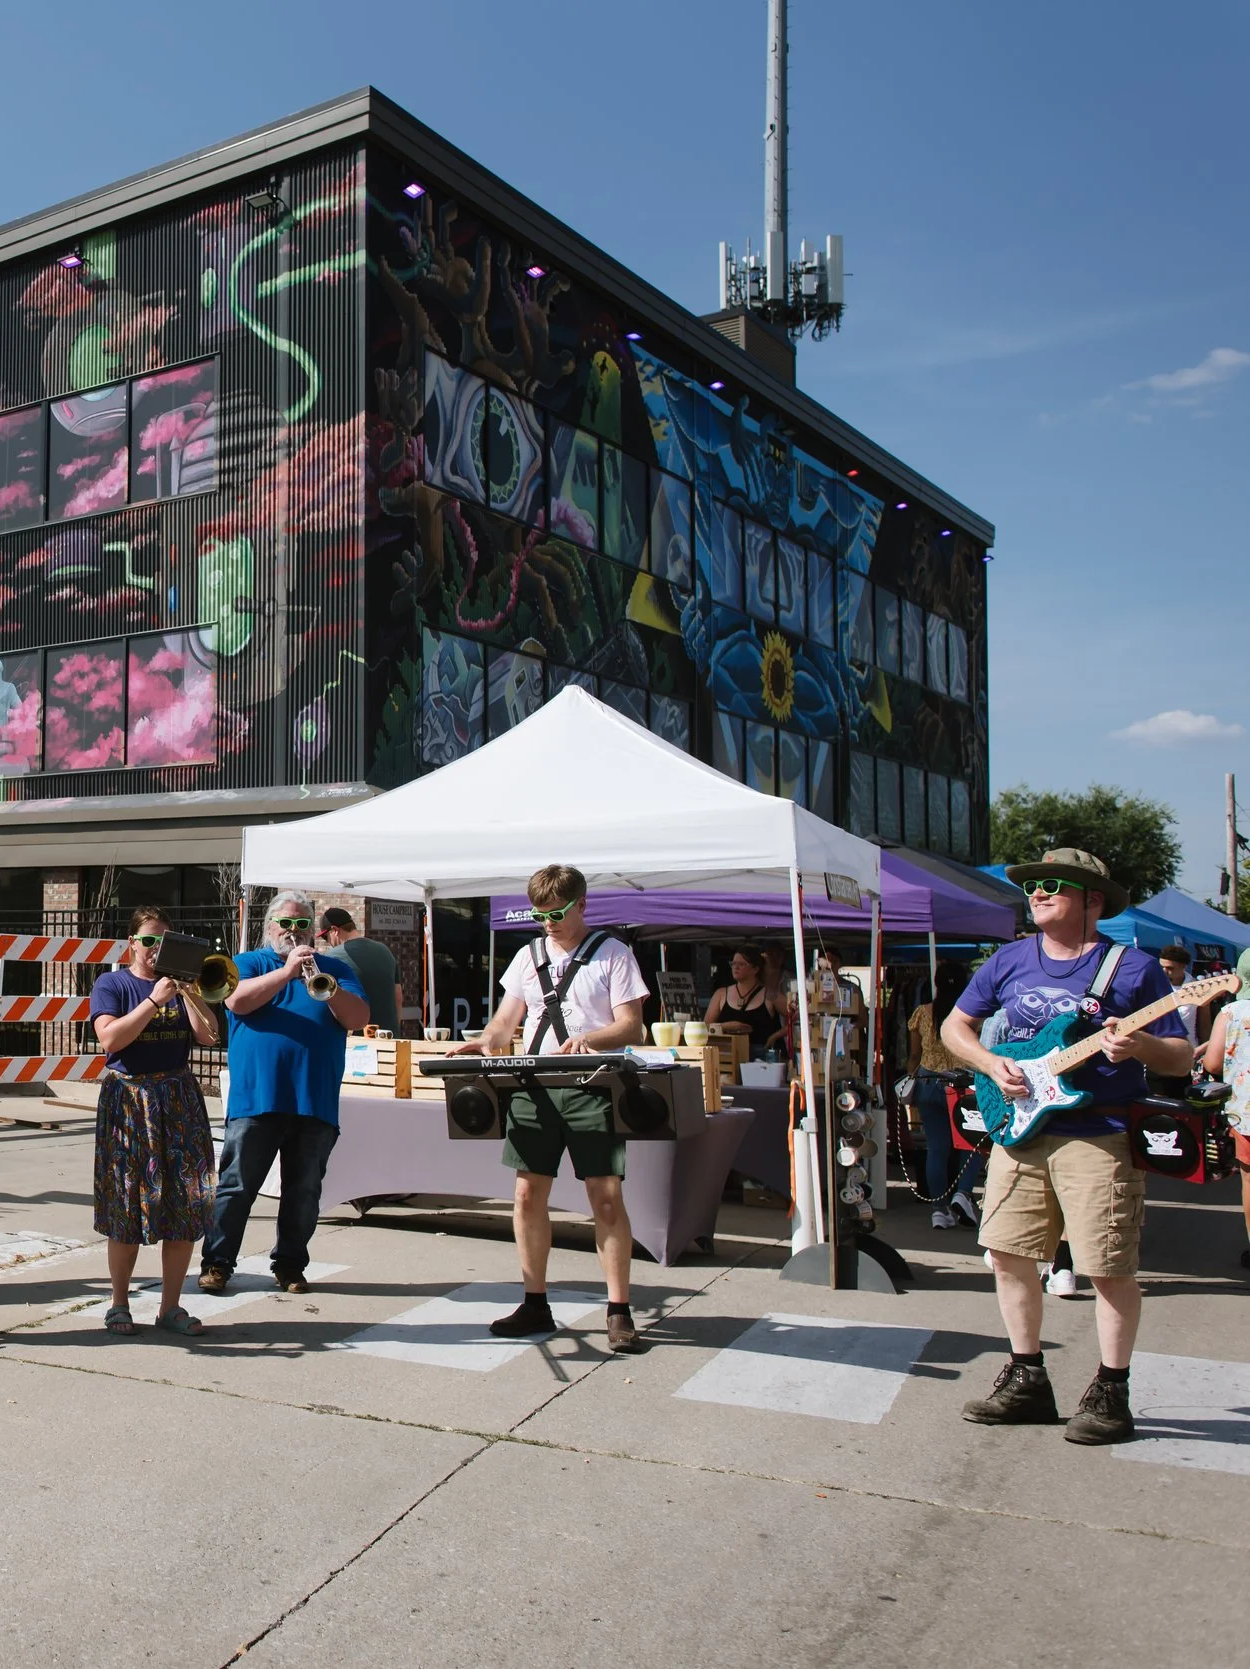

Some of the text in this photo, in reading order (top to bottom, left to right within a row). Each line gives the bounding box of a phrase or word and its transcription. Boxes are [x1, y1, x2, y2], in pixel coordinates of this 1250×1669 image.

[372, 903, 412, 916] HOUSE CAMPBELL
[481, 1058, 536, 1067] M-AUDIO
